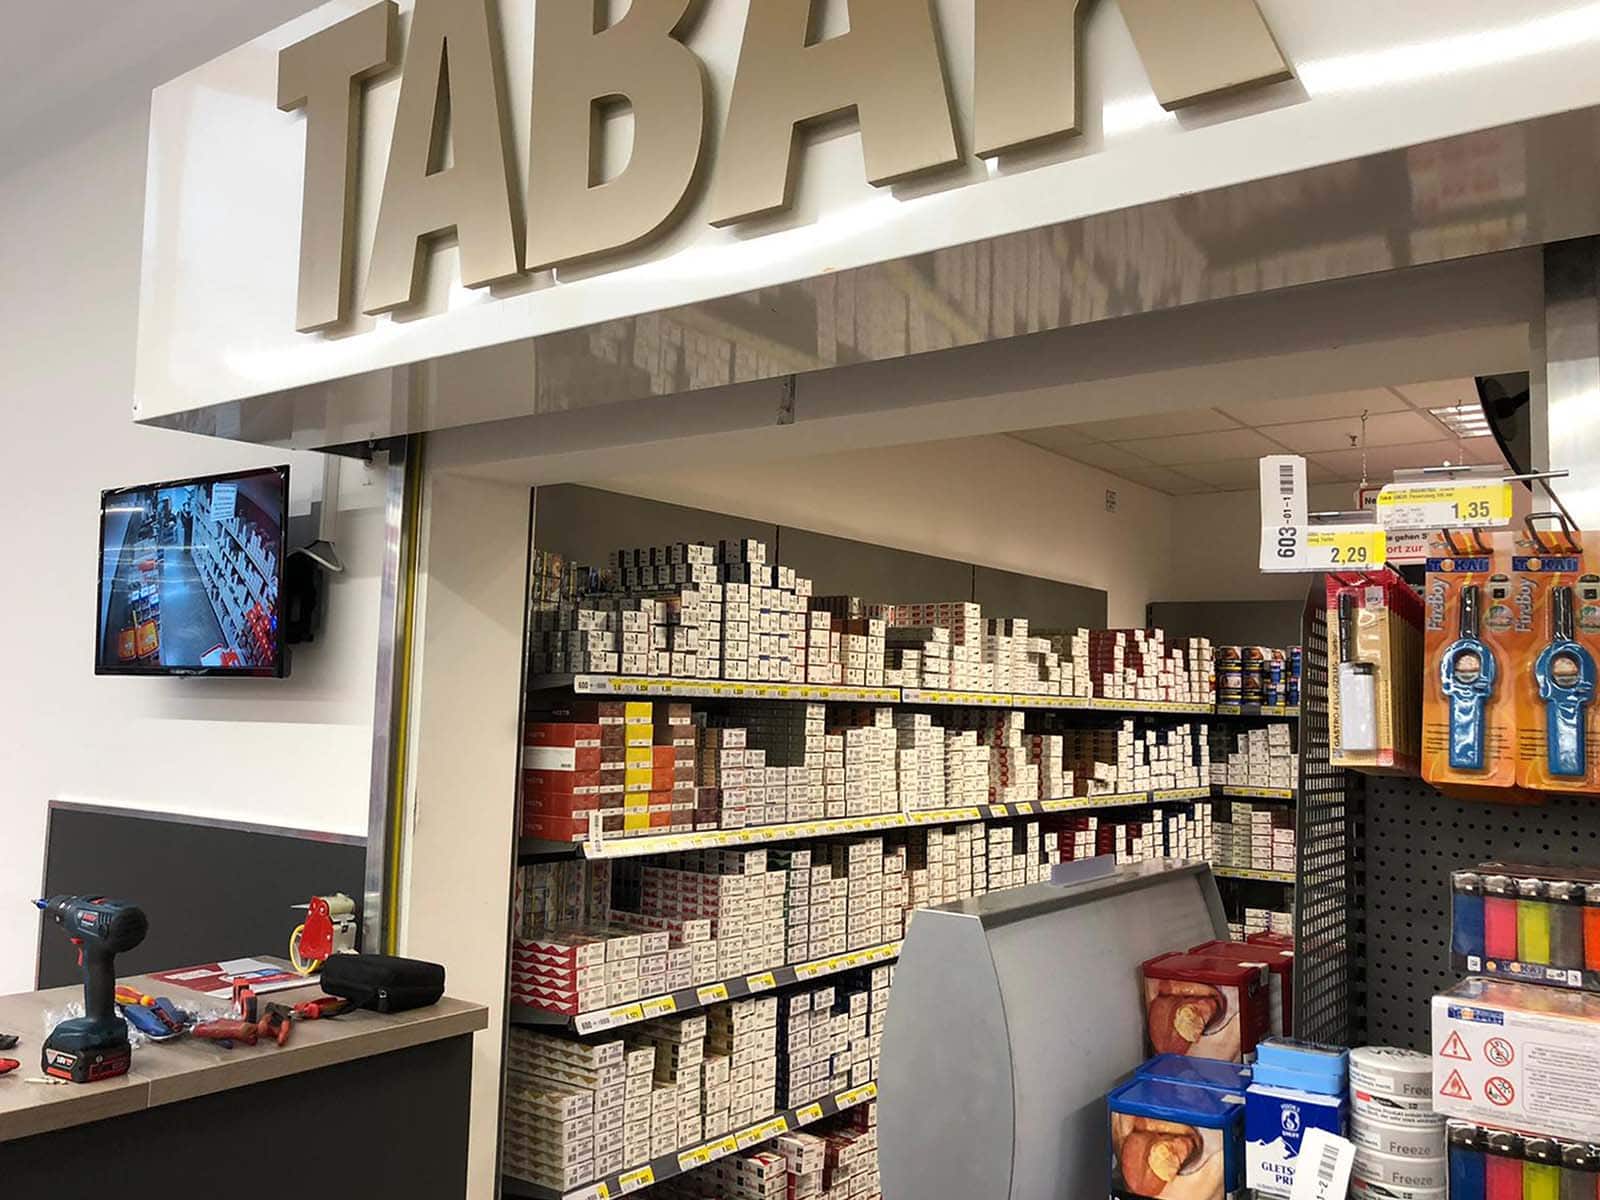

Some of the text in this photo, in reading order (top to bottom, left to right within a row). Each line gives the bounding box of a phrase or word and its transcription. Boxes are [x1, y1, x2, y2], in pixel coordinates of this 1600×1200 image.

[1451, 501, 1490, 520] 1,35
[1394, 533, 1420, 542] gehen
[1330, 546, 1367, 565] 2,29
[1405, 544, 1423, 553] zur
[1389, 1141, 1431, 1155] Freeze
[1261, 1161, 1295, 1177] GLETS
[1391, 1171, 1433, 1186] Freeze
